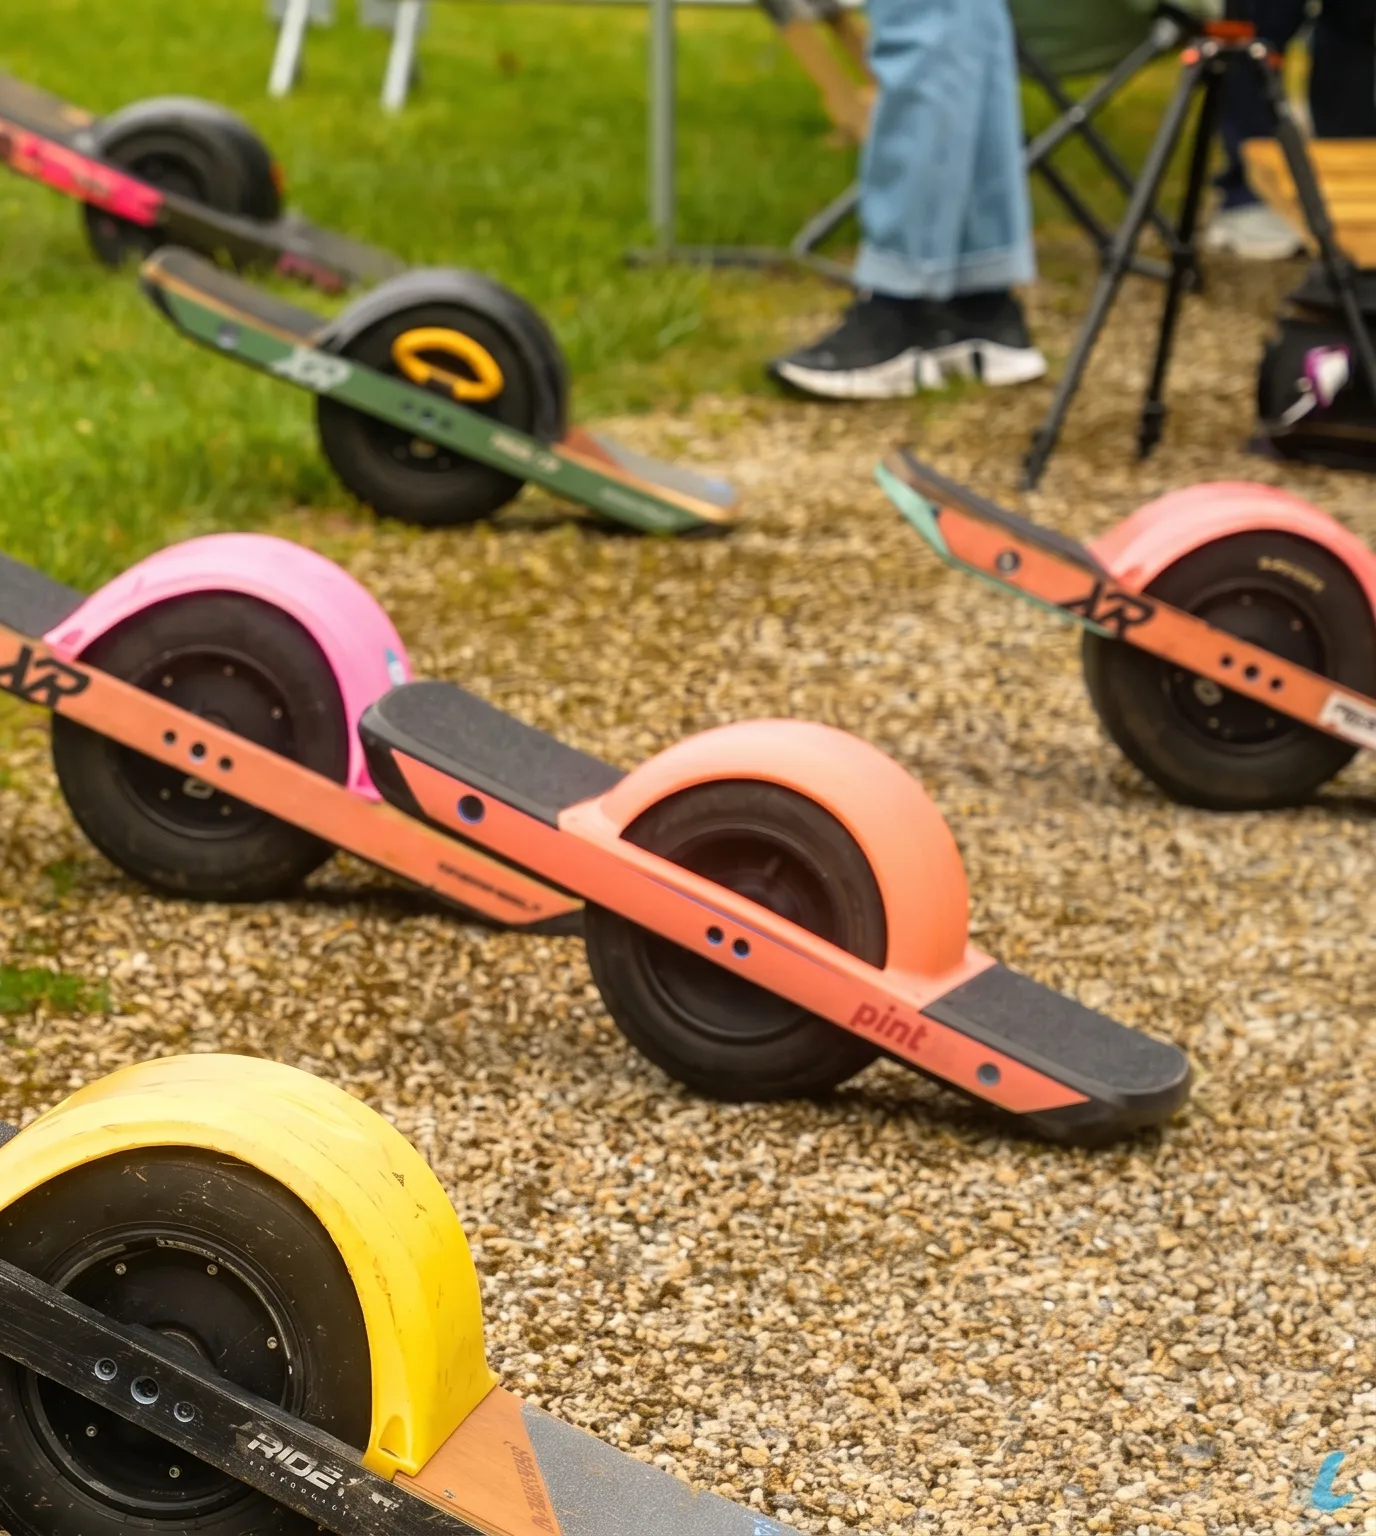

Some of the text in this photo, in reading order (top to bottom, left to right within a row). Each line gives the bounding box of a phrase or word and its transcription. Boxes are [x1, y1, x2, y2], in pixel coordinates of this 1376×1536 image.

[1058, 580, 1155, 639] XR
[848, 1002, 928, 1053] pint
[247, 1432, 343, 1491] RIDE
